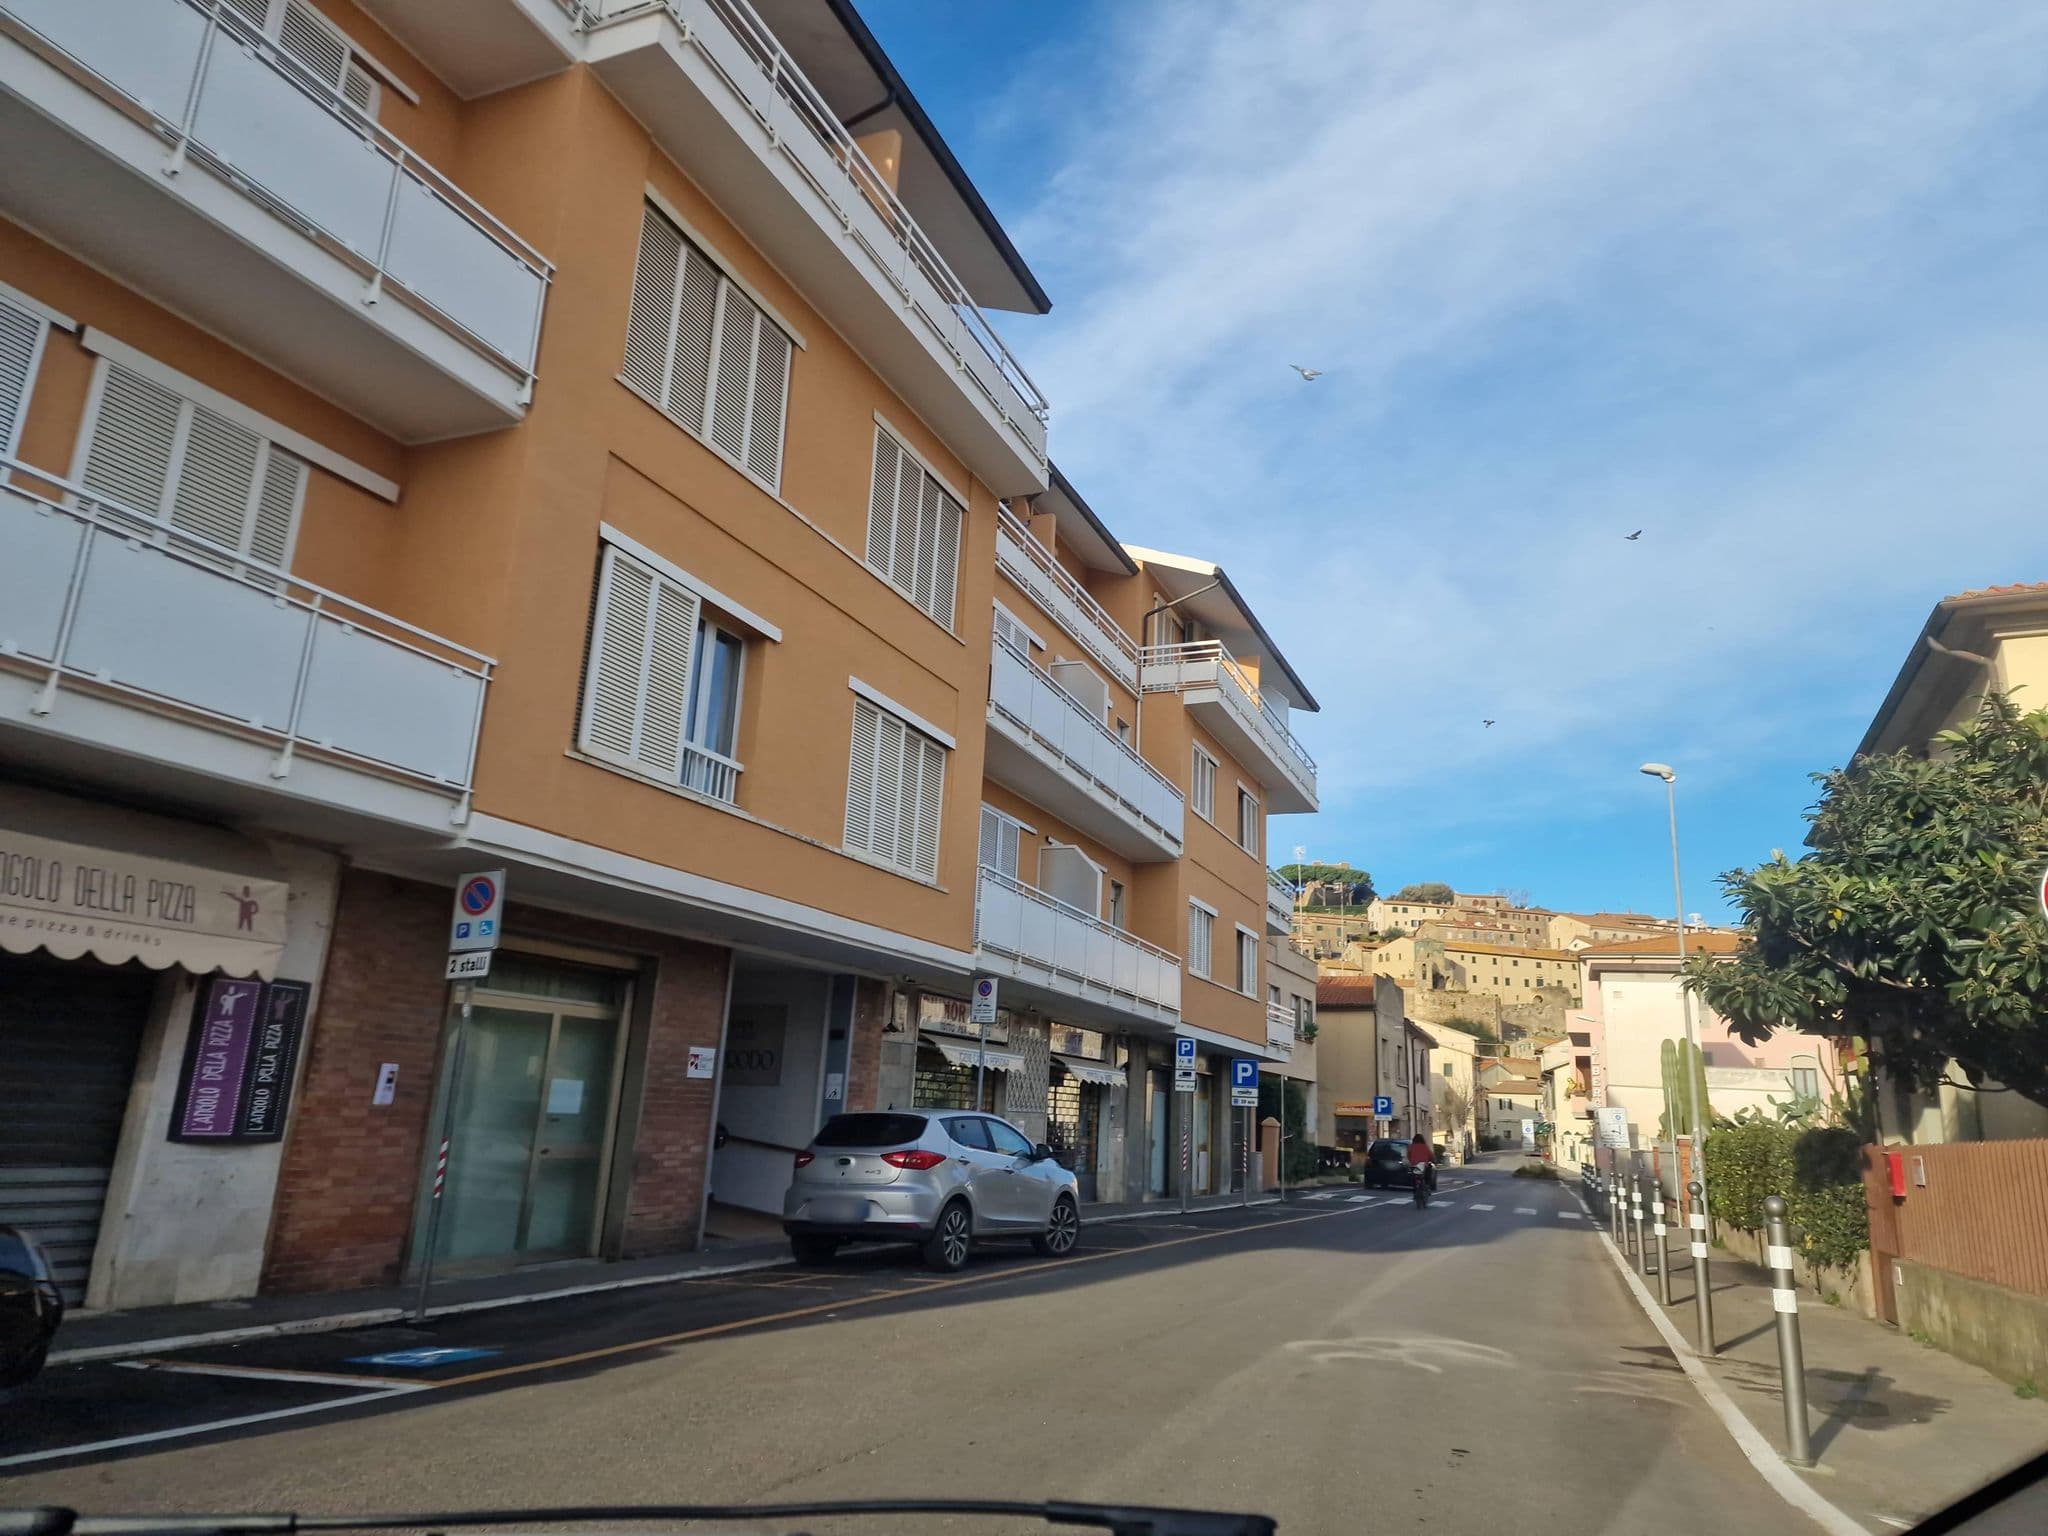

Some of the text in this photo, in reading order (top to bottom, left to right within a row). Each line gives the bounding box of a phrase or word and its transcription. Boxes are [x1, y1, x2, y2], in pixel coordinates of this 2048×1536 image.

[74, 866, 137, 915] DELLA
[146, 878, 196, 924] PIZZA
[24, 918, 78, 935] pizza
[103, 928, 162, 947] drinks
[449, 956, 487, 974] 2 stalli
[208, 1019, 234, 1047] PIZZA
[264, 1023, 283, 1049] PIZZA
[1181, 1042, 1191, 1055] P
[201, 1051, 228, 1081] DELLA
[257, 1054, 278, 1083] DELLA
[1236, 1063, 1253, 1084] P
[1377, 1098, 1389, 1113] P
